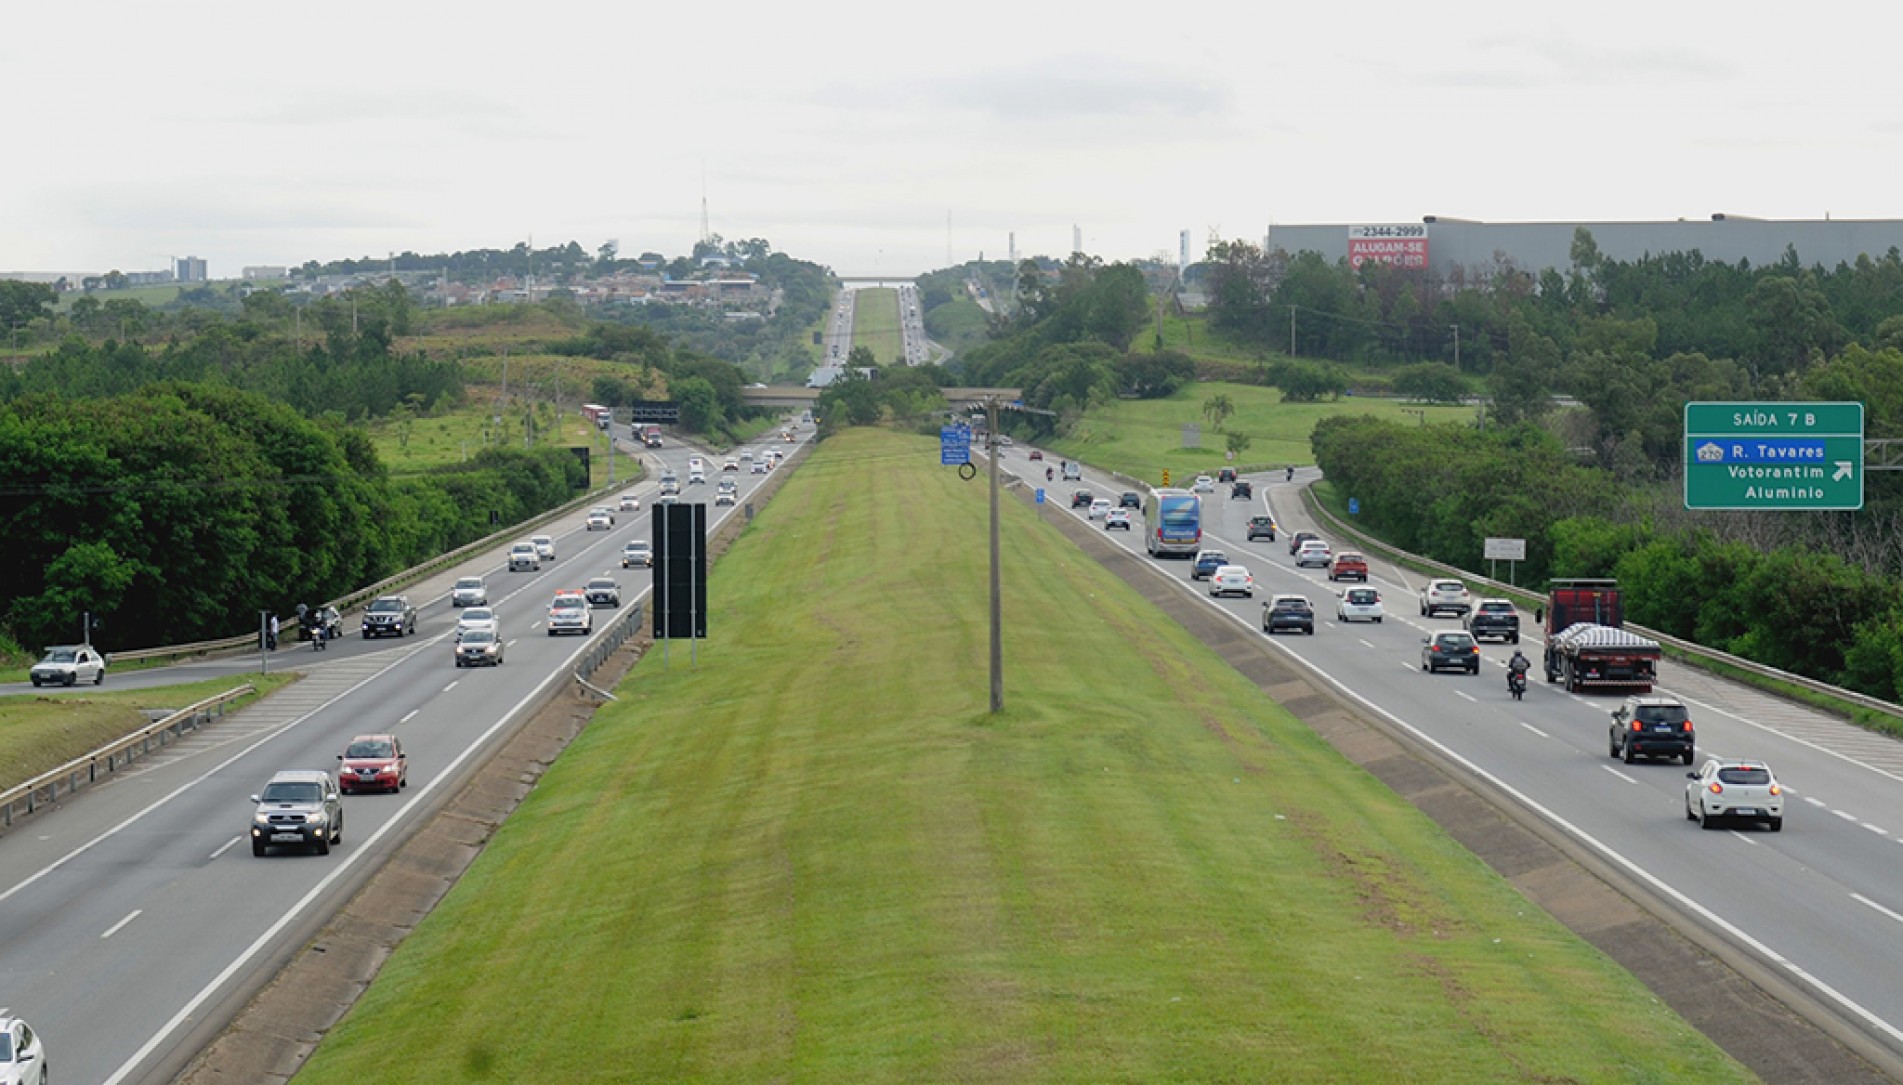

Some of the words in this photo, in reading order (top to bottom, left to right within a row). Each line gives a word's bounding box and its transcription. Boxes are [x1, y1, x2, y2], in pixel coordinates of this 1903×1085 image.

[1363, 226, 1424, 237] 2344-2999
[1353, 242, 1424, 253] ALUGAM-SE
[1733, 409, 1778, 426] SAÍDA
[1787, 413, 1798, 426] 7
[1805, 413, 1816, 426] B
[1732, 445, 1749, 458] R.
[1757, 445, 1824, 458] Tavares
[1728, 465, 1824, 478] Votorantim
